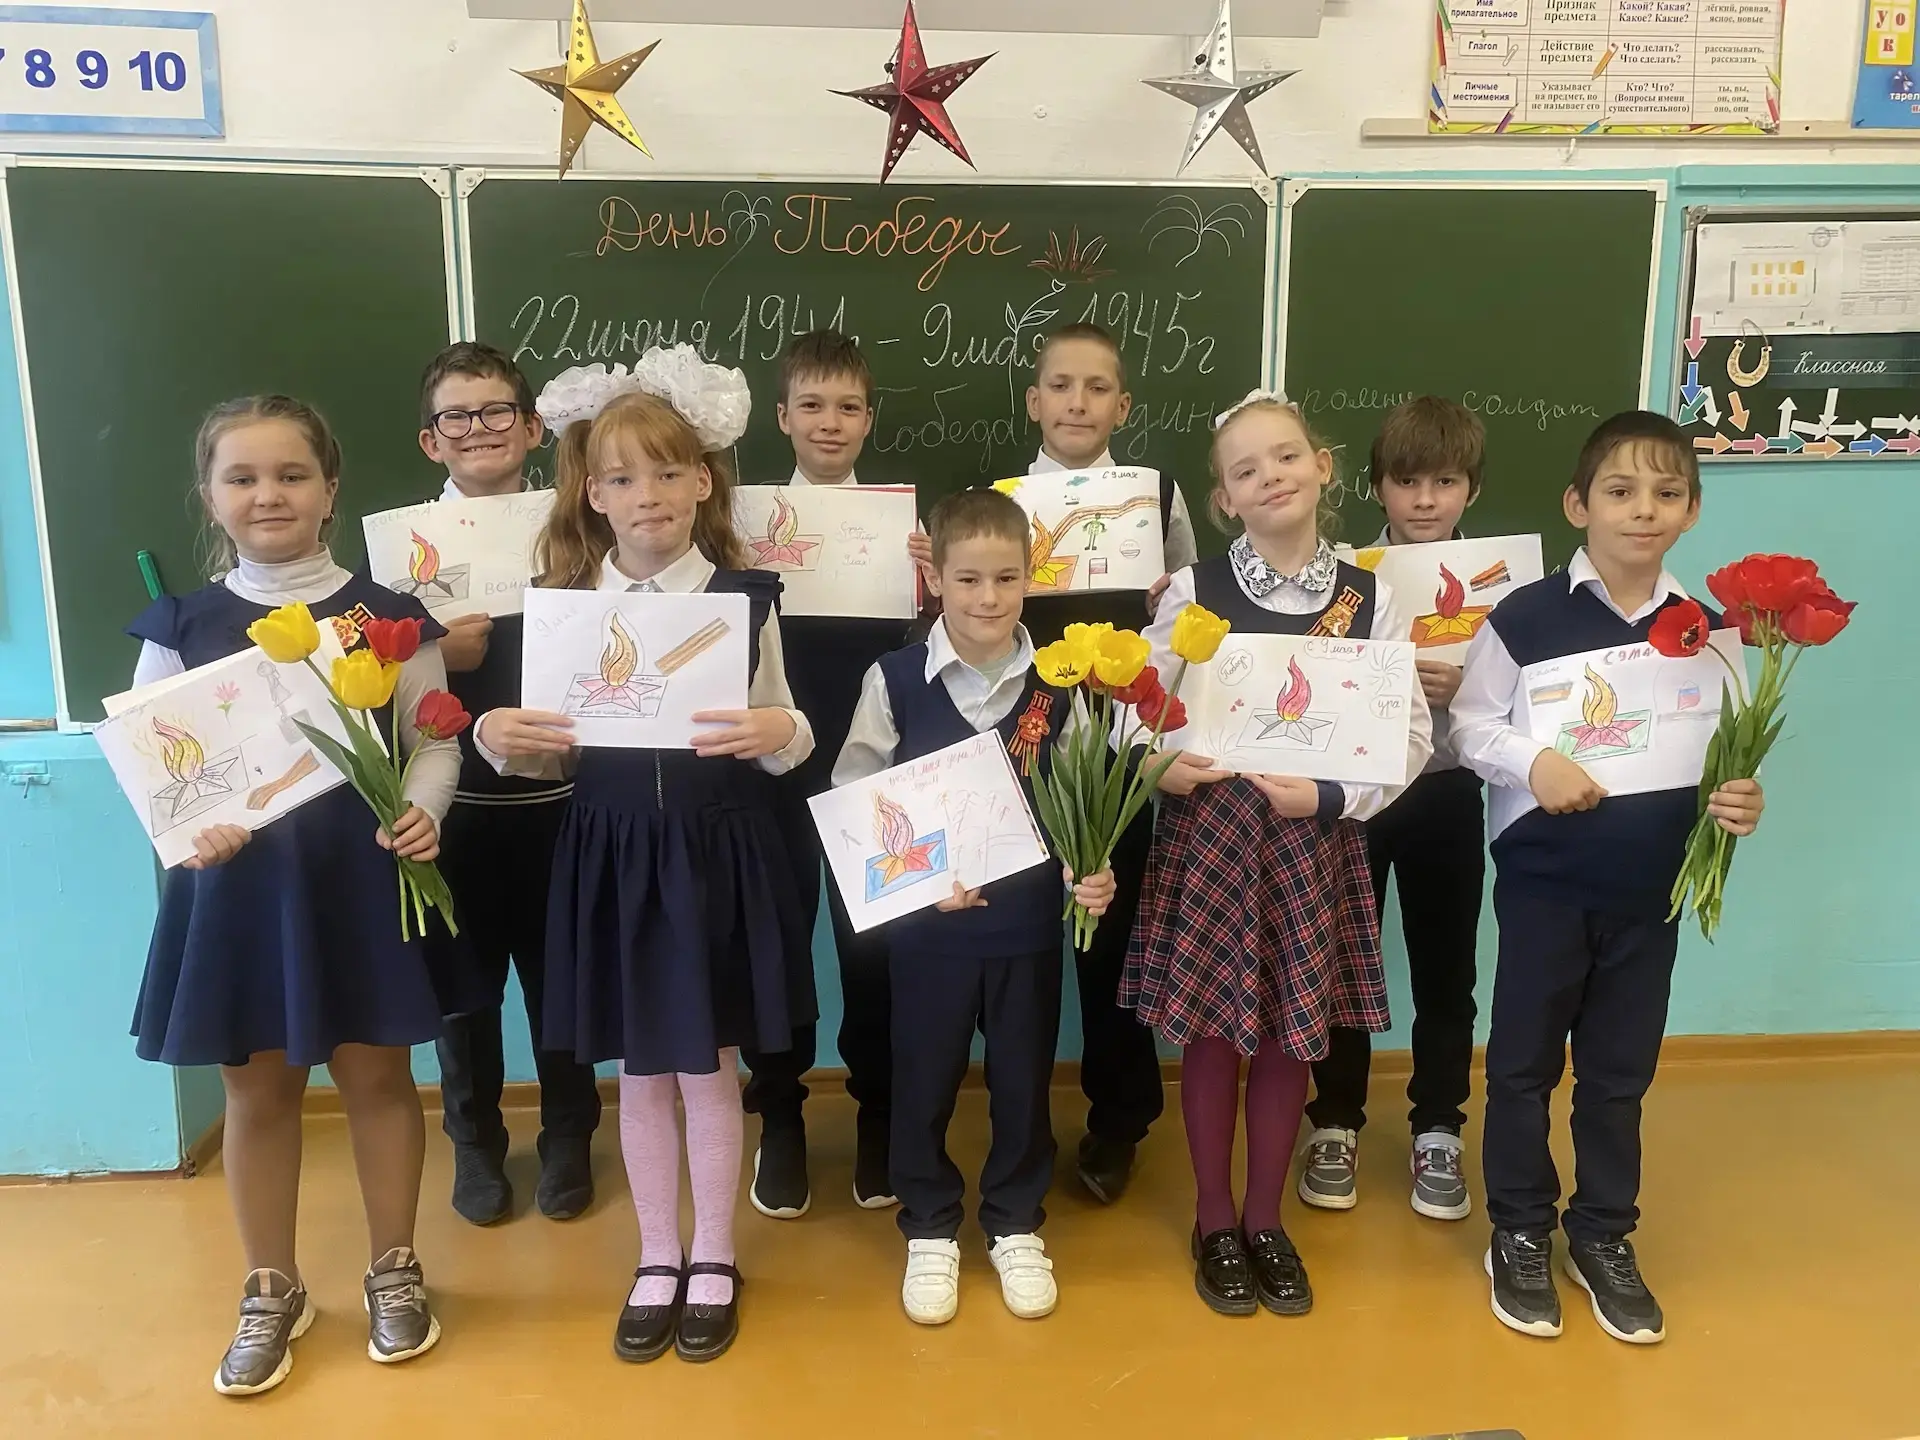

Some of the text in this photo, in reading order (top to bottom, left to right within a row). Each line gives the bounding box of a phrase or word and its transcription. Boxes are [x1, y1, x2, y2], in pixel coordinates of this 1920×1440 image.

[1546, 0, 1597, 11] Признак
[1619, 1, 1691, 11] Какой? Какая?
[1450, 9, 1518, 19] прилагательное
[1544, 12, 1597, 23] предмета
[1619, 13, 1689, 23] Какое? Какие?
[1468, 41, 1498, 51] Глагол
[1540, 39, 1594, 52] Действие
[1623, 43, 1680, 53] Что делать?
[1540, 52, 1594, 64] предмета
[1620, 54, 1682, 64] Что сделать?
[1711, 57, 1757, 66] рассказать
[24, 48, 187, 92] 8 9 10
[1464, 82, 1499, 92] Личные
[1541, 82, 1593, 92] Указывает
[1626, 83, 1675, 92] Кто? Что?
[1452, 93, 1510, 102] местоимения
[1535, 93, 1546, 101] на
[1548, 93, 1585, 103] предмет,
[1614, 94, 1656, 104] (Вопросы
[1608, 105, 1690, 114] существительного)
[596, 193, 1022, 292] День Победы
[1793, 350, 1887, 374] Классная
[1462, 389, 1600, 431] солдат
